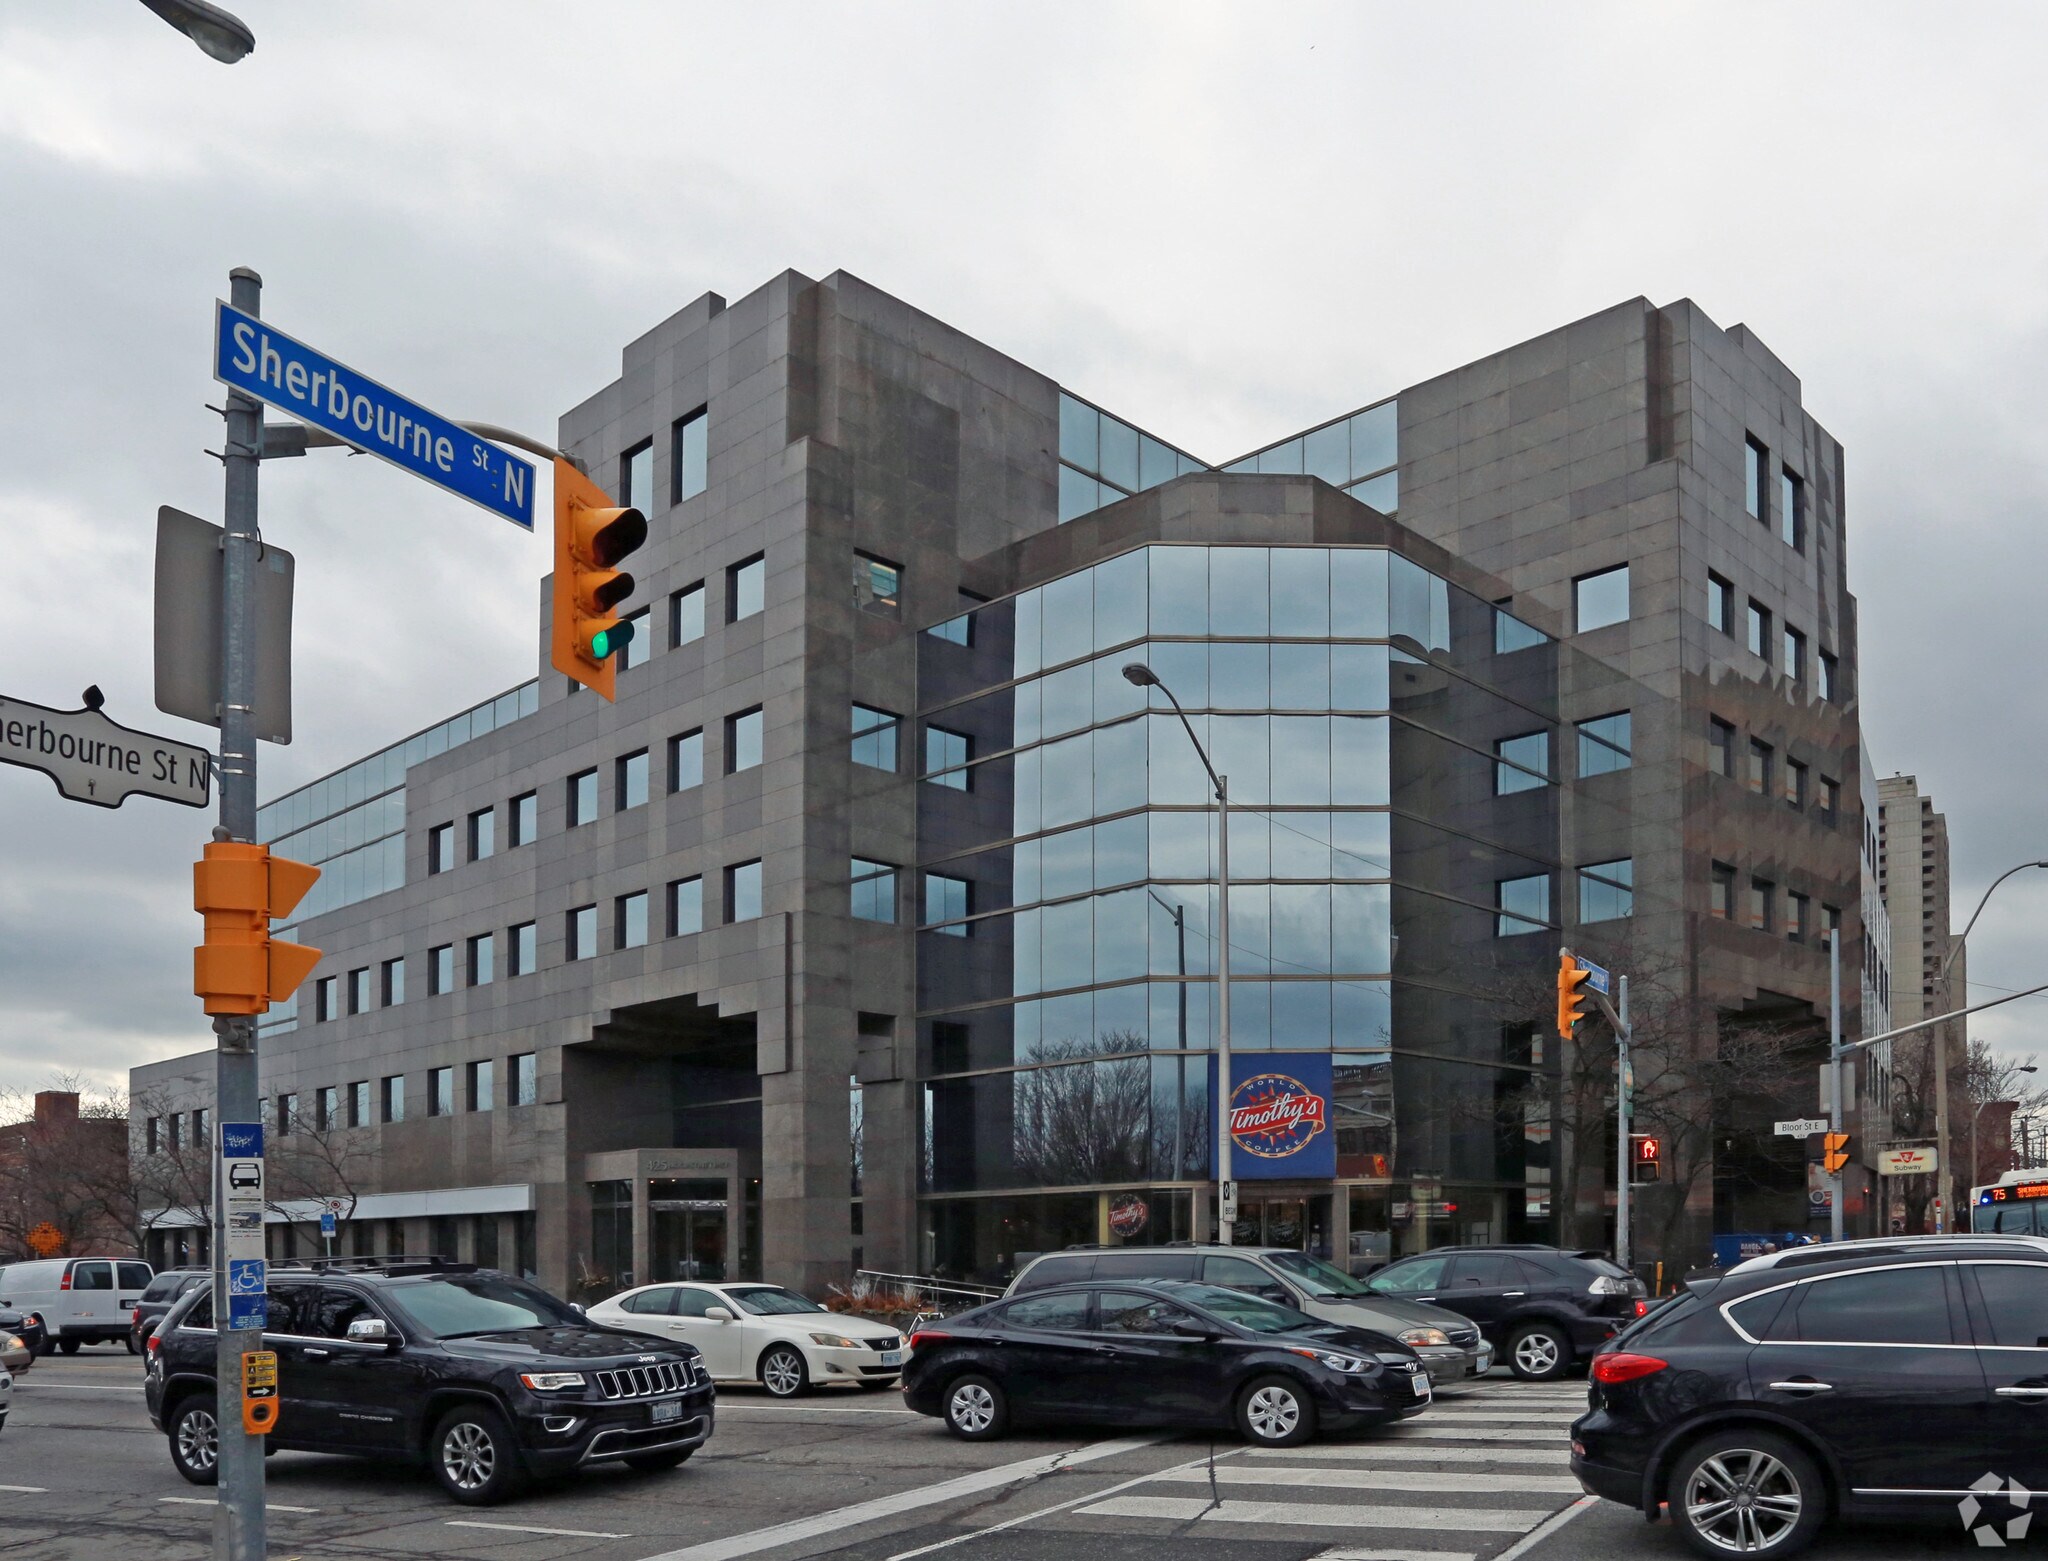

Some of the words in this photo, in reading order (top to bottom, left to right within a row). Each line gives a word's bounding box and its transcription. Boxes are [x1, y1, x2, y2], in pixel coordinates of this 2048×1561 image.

[232, 322, 454, 472] Sherbourne
[472, 444, 488, 471] St
[504, 460, 525, 508] N
[0, 718, 141, 775] erbourne
[152, 749, 178, 784] St
[189, 757, 207, 791] N
[1246, 1079, 1296, 1091] WORLD
[1230, 1093, 1318, 1129] Timothy's
[1782, 1123, 1802, 1132] Bloor
[1804, 1122, 1812, 1131] St
[1814, 1121, 1819, 1130] E
[1245, 1140, 1301, 1153] COFFEE
[1993, 1188, 2006, 1200] 75
